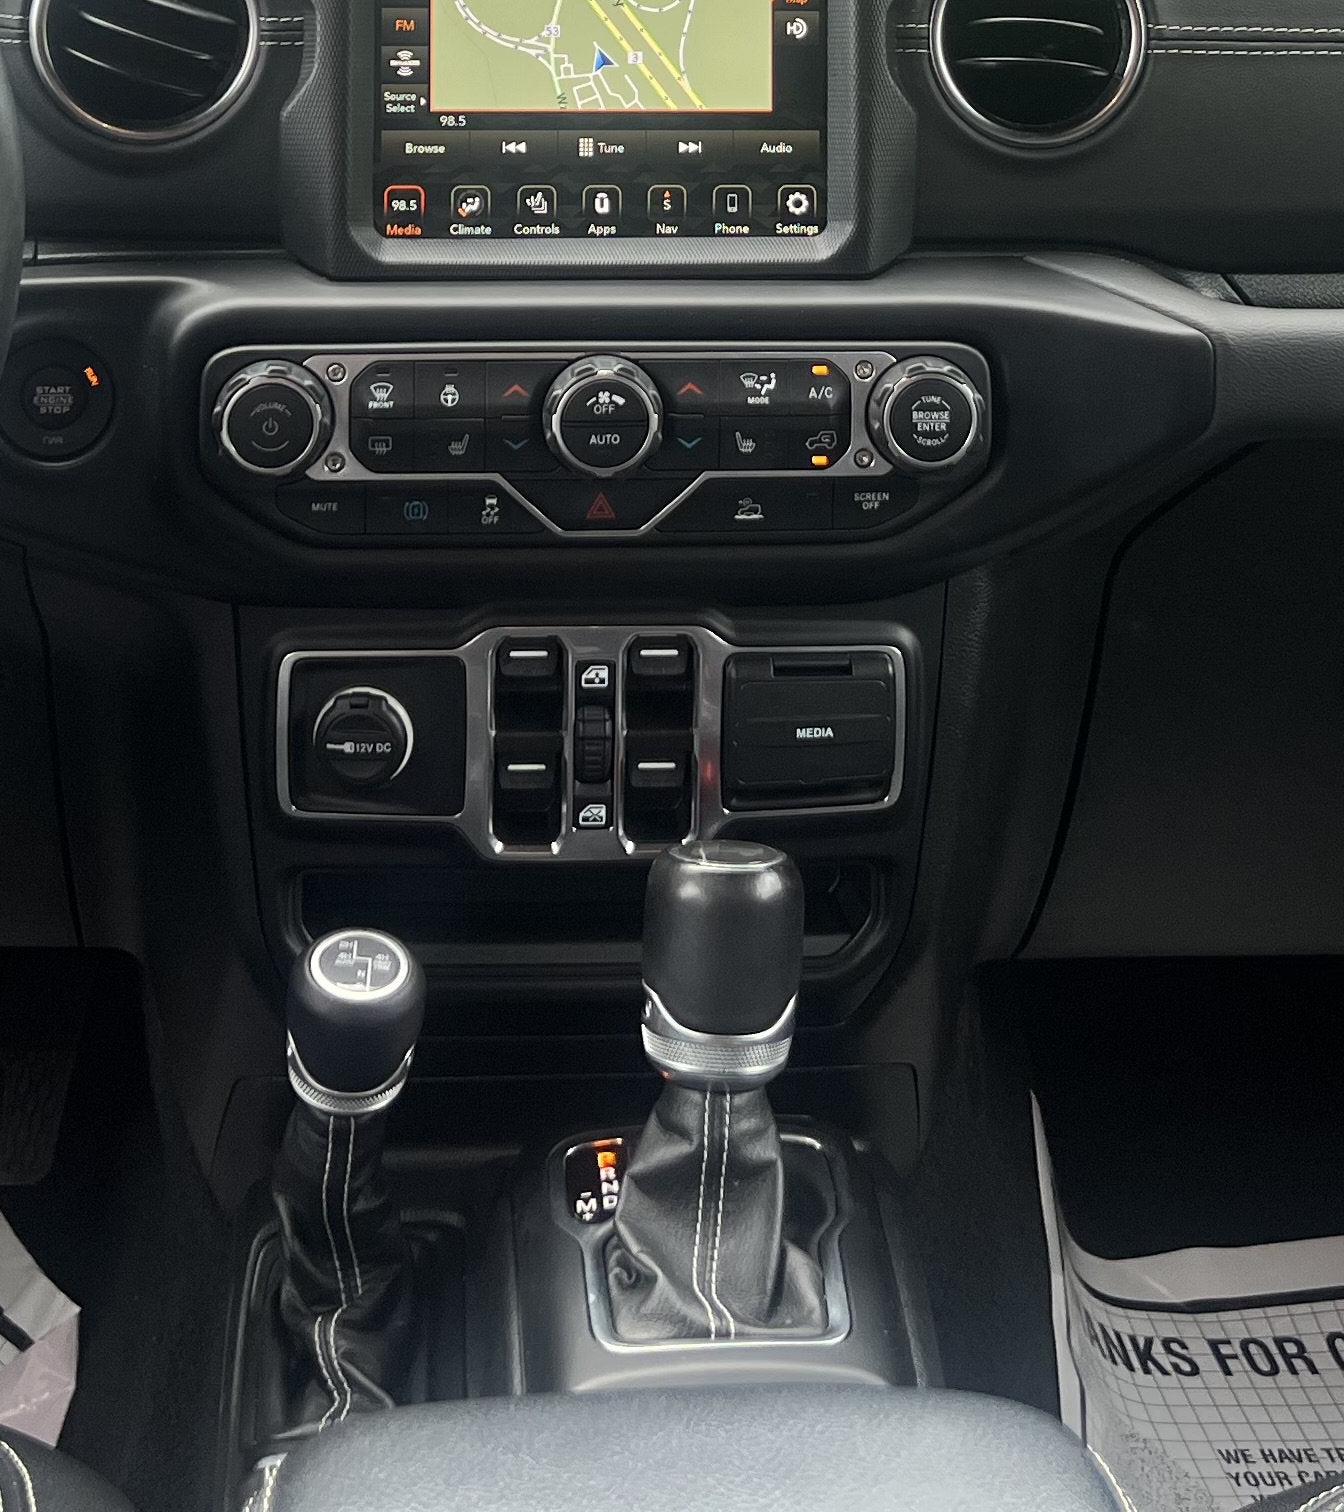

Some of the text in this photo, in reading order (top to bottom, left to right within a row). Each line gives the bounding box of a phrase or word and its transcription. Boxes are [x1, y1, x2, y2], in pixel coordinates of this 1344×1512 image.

[395, 19, 416, 32] FM
[545, 26, 559, 36] 53
[384, 91, 417, 102] Source
[385, 103, 416, 113] Select
[439, 115, 467, 127] 98.5
[405, 142, 446, 154] Browse
[598, 142, 625, 154] Tune
[760, 142, 793, 154] Audio
[391, 199, 418, 212] 98.5
[386, 224, 422, 236] Media
[449, 224, 492, 235] Climate
[513, 223, 560, 235] Controls
[587, 223, 617, 237] Apps
[656, 223, 679, 235] Nav
[714, 223, 750, 235] Phone
[775, 223, 819, 237] Settings
[36, 386, 72, 394] START
[808, 387, 833, 399] A/C
[368, 401, 394, 410] FRONT
[747, 396, 770, 405] MODE
[921, 395, 942, 404] TUNE
[39, 406, 71, 414] STOP
[593, 404, 616, 415] OFF
[912, 410, 951, 420] BROWSE
[917, 422, 947, 432] ENTER
[589, 433, 621, 446] AUTO
[916, 434, 945, 447] SCROLL
[854, 492, 890, 501] SCREEN
[311, 502, 338, 512] MUTE
[862, 501, 881, 510] OFF
[481, 516, 500, 525] OFF
[796, 727, 834, 738] MEDIA
[356, 742, 392, 753] 12V DC
[601, 1180, 619, 1195] N
[576, 1198, 597, 1214] M
[602, 1195, 618, 1210] D
[1205, 1336, 1320, 1377] FOR
[1217, 1448, 1256, 1464] WE
[1260, 1448, 1320, 1464] HAVE
[1226, 1471, 1293, 1488] YOUR
